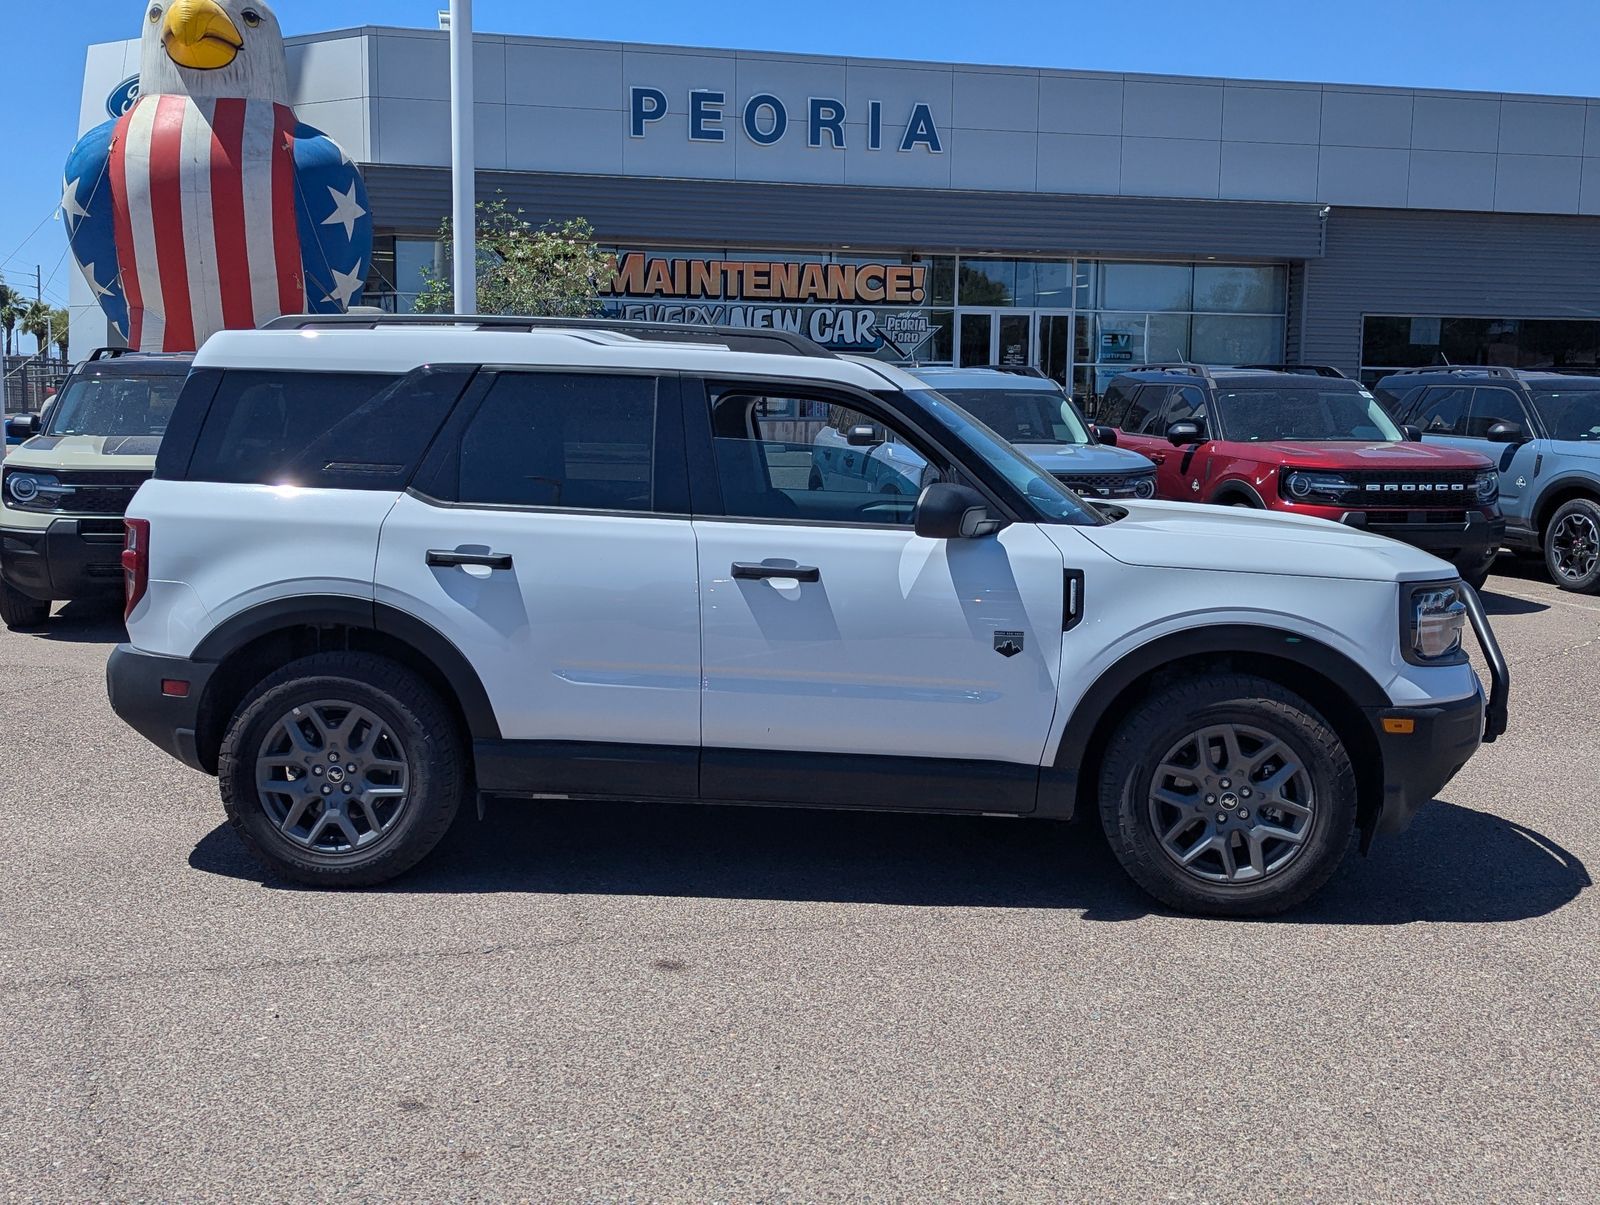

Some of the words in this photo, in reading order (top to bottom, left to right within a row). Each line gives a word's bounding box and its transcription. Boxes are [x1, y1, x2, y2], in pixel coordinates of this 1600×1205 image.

[630, 86, 943, 153] PEORIA
[601, 250, 927, 304] MAINTENANCE!
[809, 308, 878, 345] CAR
[887, 317, 927, 331] PEORIA
[891, 330, 919, 342] FORD
